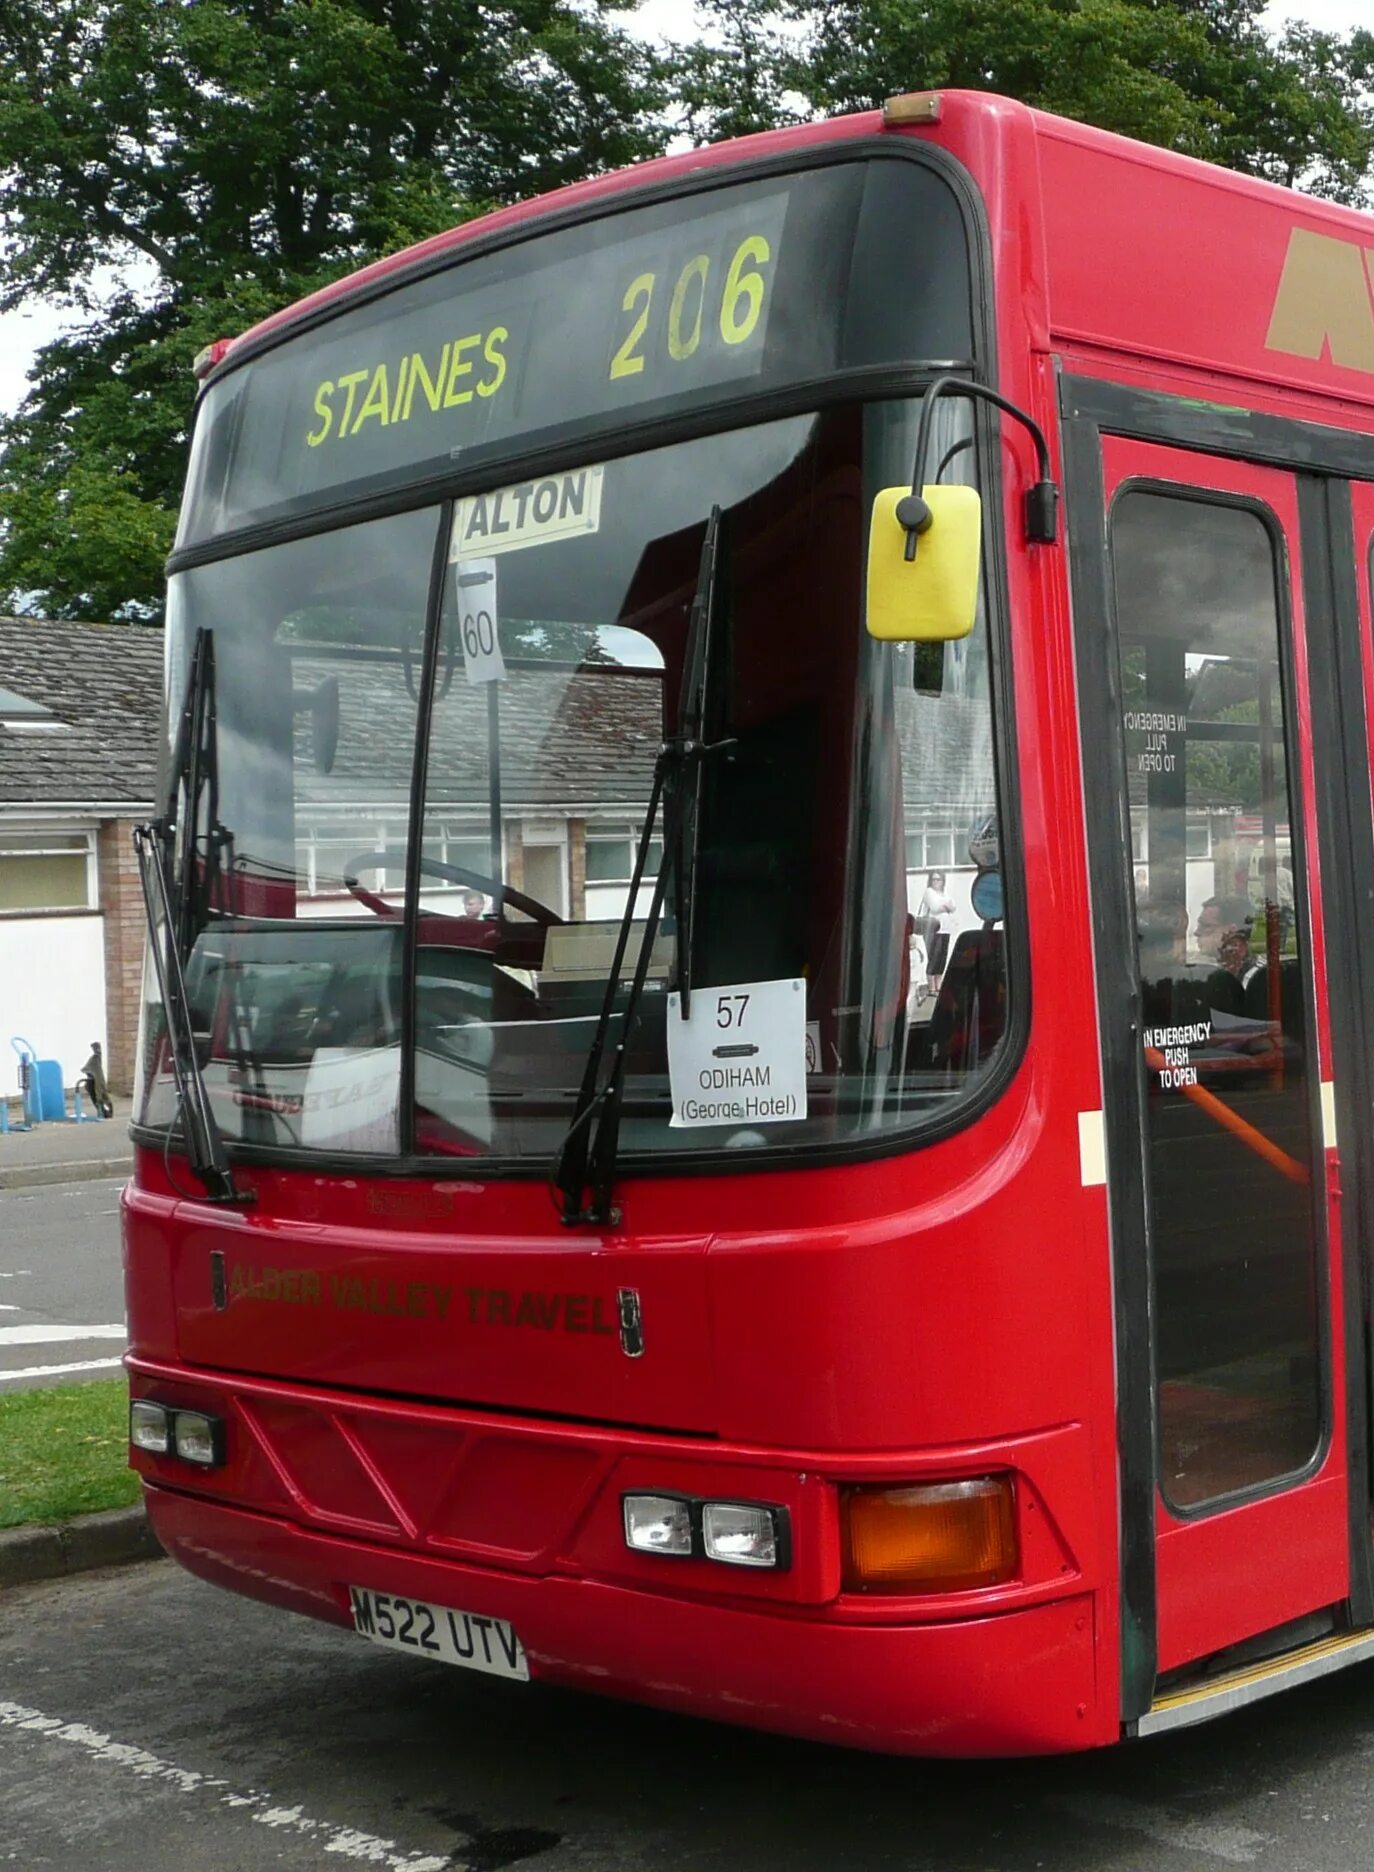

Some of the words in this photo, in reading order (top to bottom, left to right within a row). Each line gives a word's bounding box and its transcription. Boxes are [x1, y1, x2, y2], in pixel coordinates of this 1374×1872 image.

[609, 235, 771, 380] 206
[306, 326, 509, 447] STAINES
[464, 470, 588, 540] ALTON
[463, 611, 494, 658] 60
[716, 994, 750, 1029] 57
[1143, 1029, 1153, 1048] IN
[1154, 1021, 1211, 1047] EMERGENCY
[1165, 1046, 1189, 1066] PUSH
[699, 1065, 771, 1090] ODIHAM
[1159, 1069, 1172, 1088] TO
[1173, 1066, 1198, 1087] OPEN
[745, 1094, 797, 1117] Hotel)
[228, 1264, 320, 1306] ALDER
[328, 1273, 453, 1320] VALLEY
[464, 1288, 614, 1335] TRAVEL
[351, 1587, 441, 1651] M522
[447, 1611, 518, 1669] UTV
